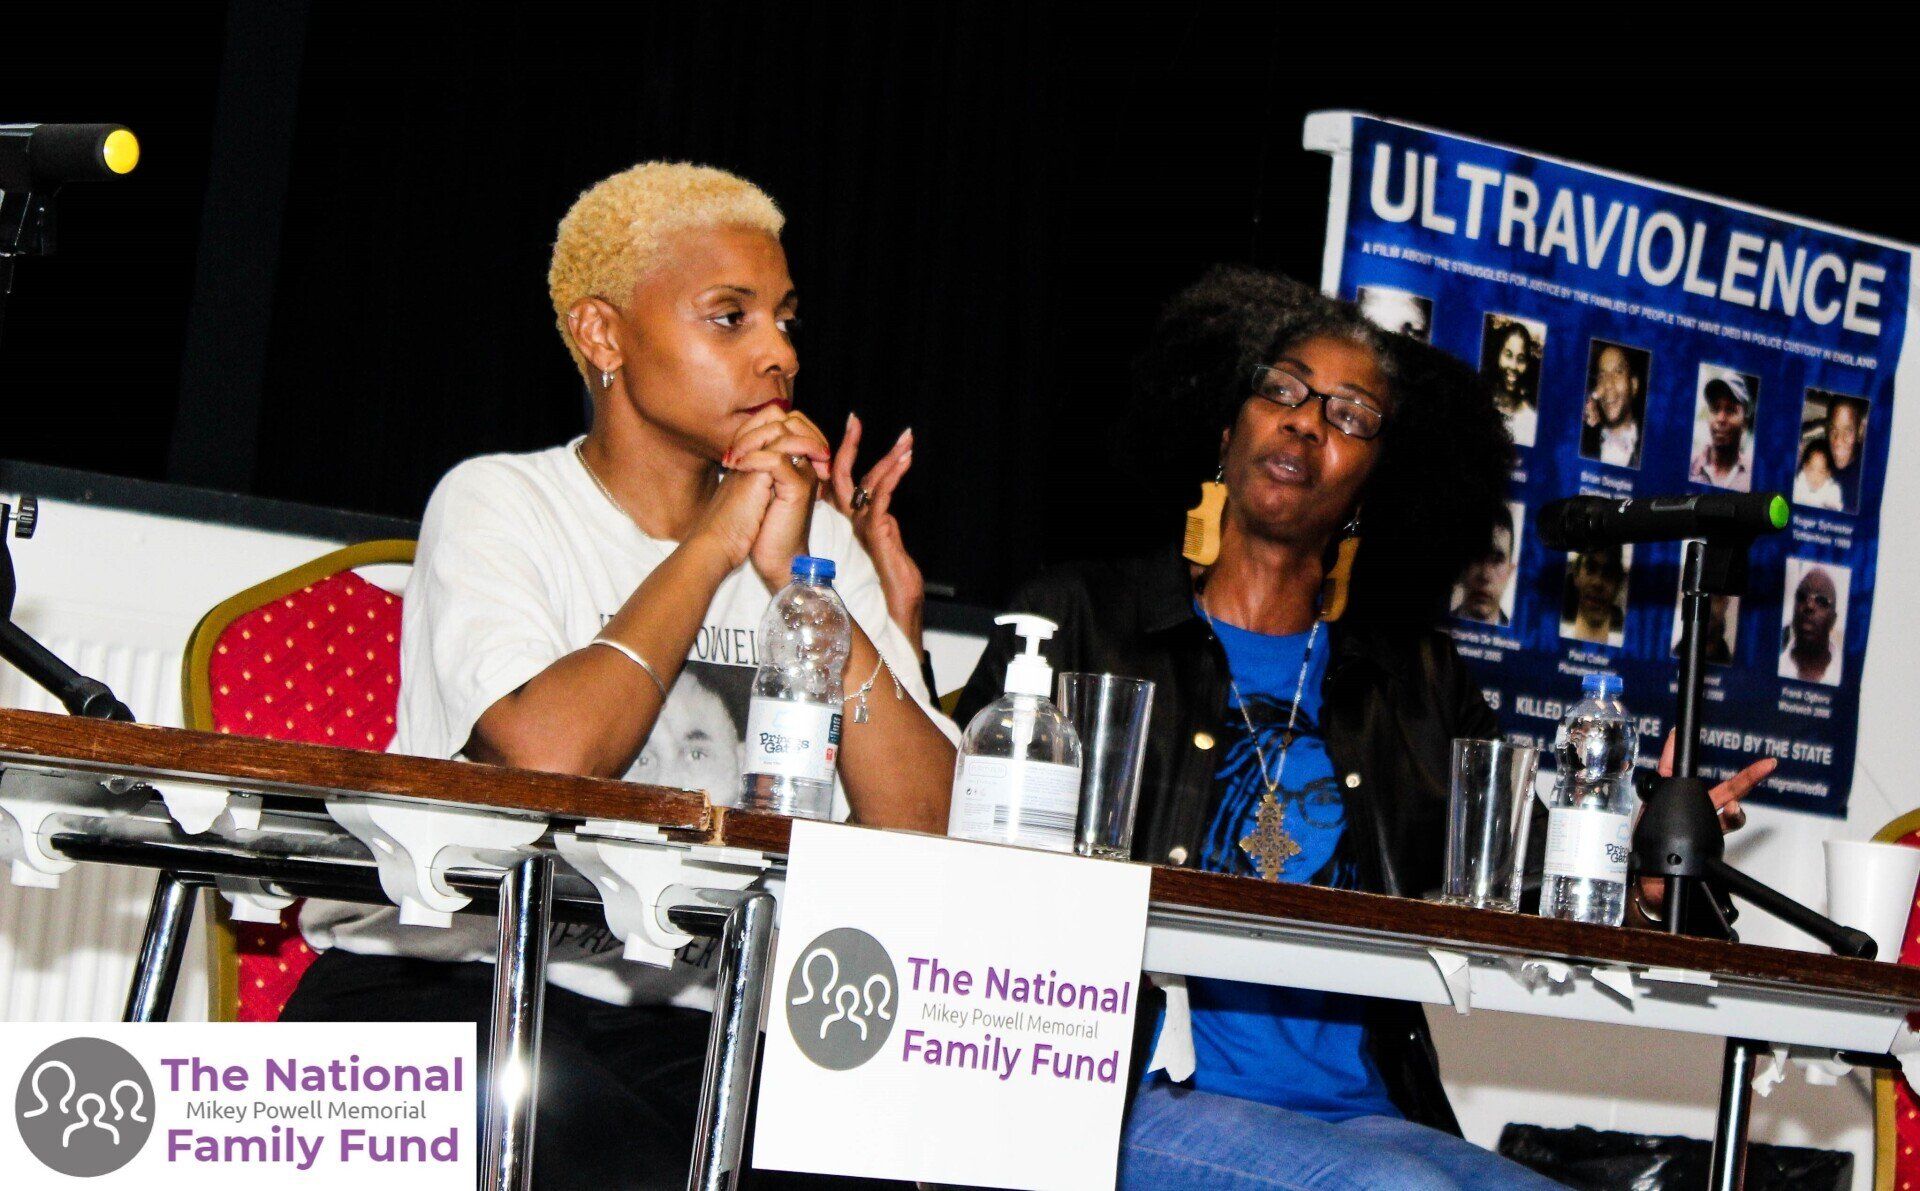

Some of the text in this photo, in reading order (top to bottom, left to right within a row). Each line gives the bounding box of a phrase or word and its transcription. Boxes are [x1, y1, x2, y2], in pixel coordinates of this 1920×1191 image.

[1370, 143, 1887, 337] ULTRAVIOLENCE
[1372, 243, 1400, 258] FILM
[1401, 247, 1433, 266] ABOUT
[1434, 257, 1450, 271] THE
[1451, 259, 1510, 283] STRUGGLES
[1641, 305, 1675, 325] PEOPLE
[1676, 314, 1698, 330] THAT
[1698, 320, 1720, 335] HAVE
[1751, 332, 1783, 349] POLICE
[1783, 339, 1823, 357] CUSTODY
[1832, 350, 1878, 370] ENGLAND
[1516, 695, 1562, 721] KILLED
[1743, 733, 1763, 754] BY
[1764, 738, 1790, 759] THE
[1791, 742, 1833, 766] STATE
[908, 957, 1130, 1015] The National
[922, 1002, 1099, 1040] Mikey Powell Memorial
[902, 1029, 1119, 1084] Family Fund
